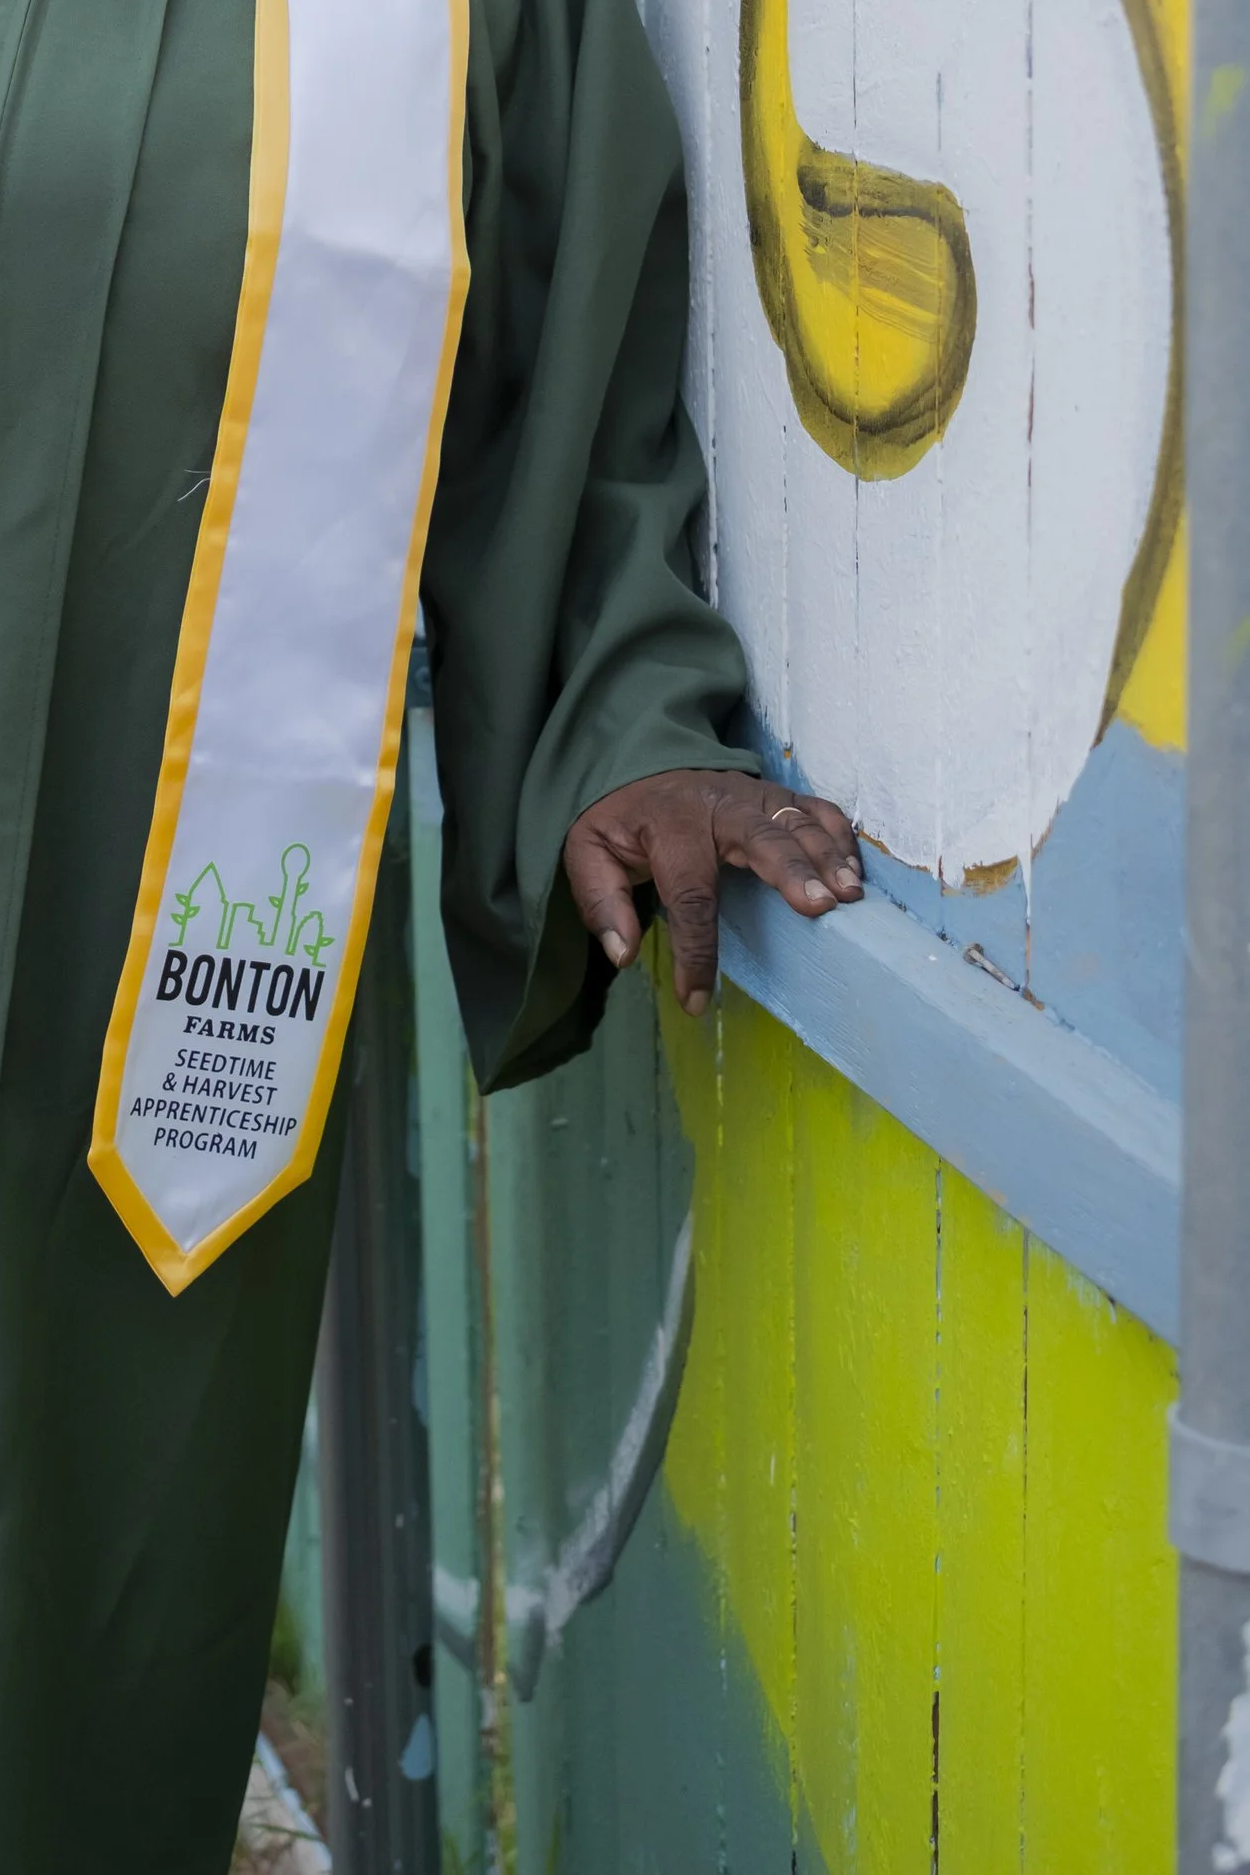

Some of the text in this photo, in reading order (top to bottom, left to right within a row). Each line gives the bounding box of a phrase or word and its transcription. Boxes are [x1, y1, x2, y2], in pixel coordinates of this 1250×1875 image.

[155, 948, 327, 1022] BONTON
[182, 1015, 277, 1045] FARMS
[174, 1048, 277, 1081] SEEDTIME
[161, 1072, 278, 1106] & HARVEST
[129, 1097, 298, 1137] APPRENTICESHIP
[153, 1127, 258, 1160] PROGRAM
